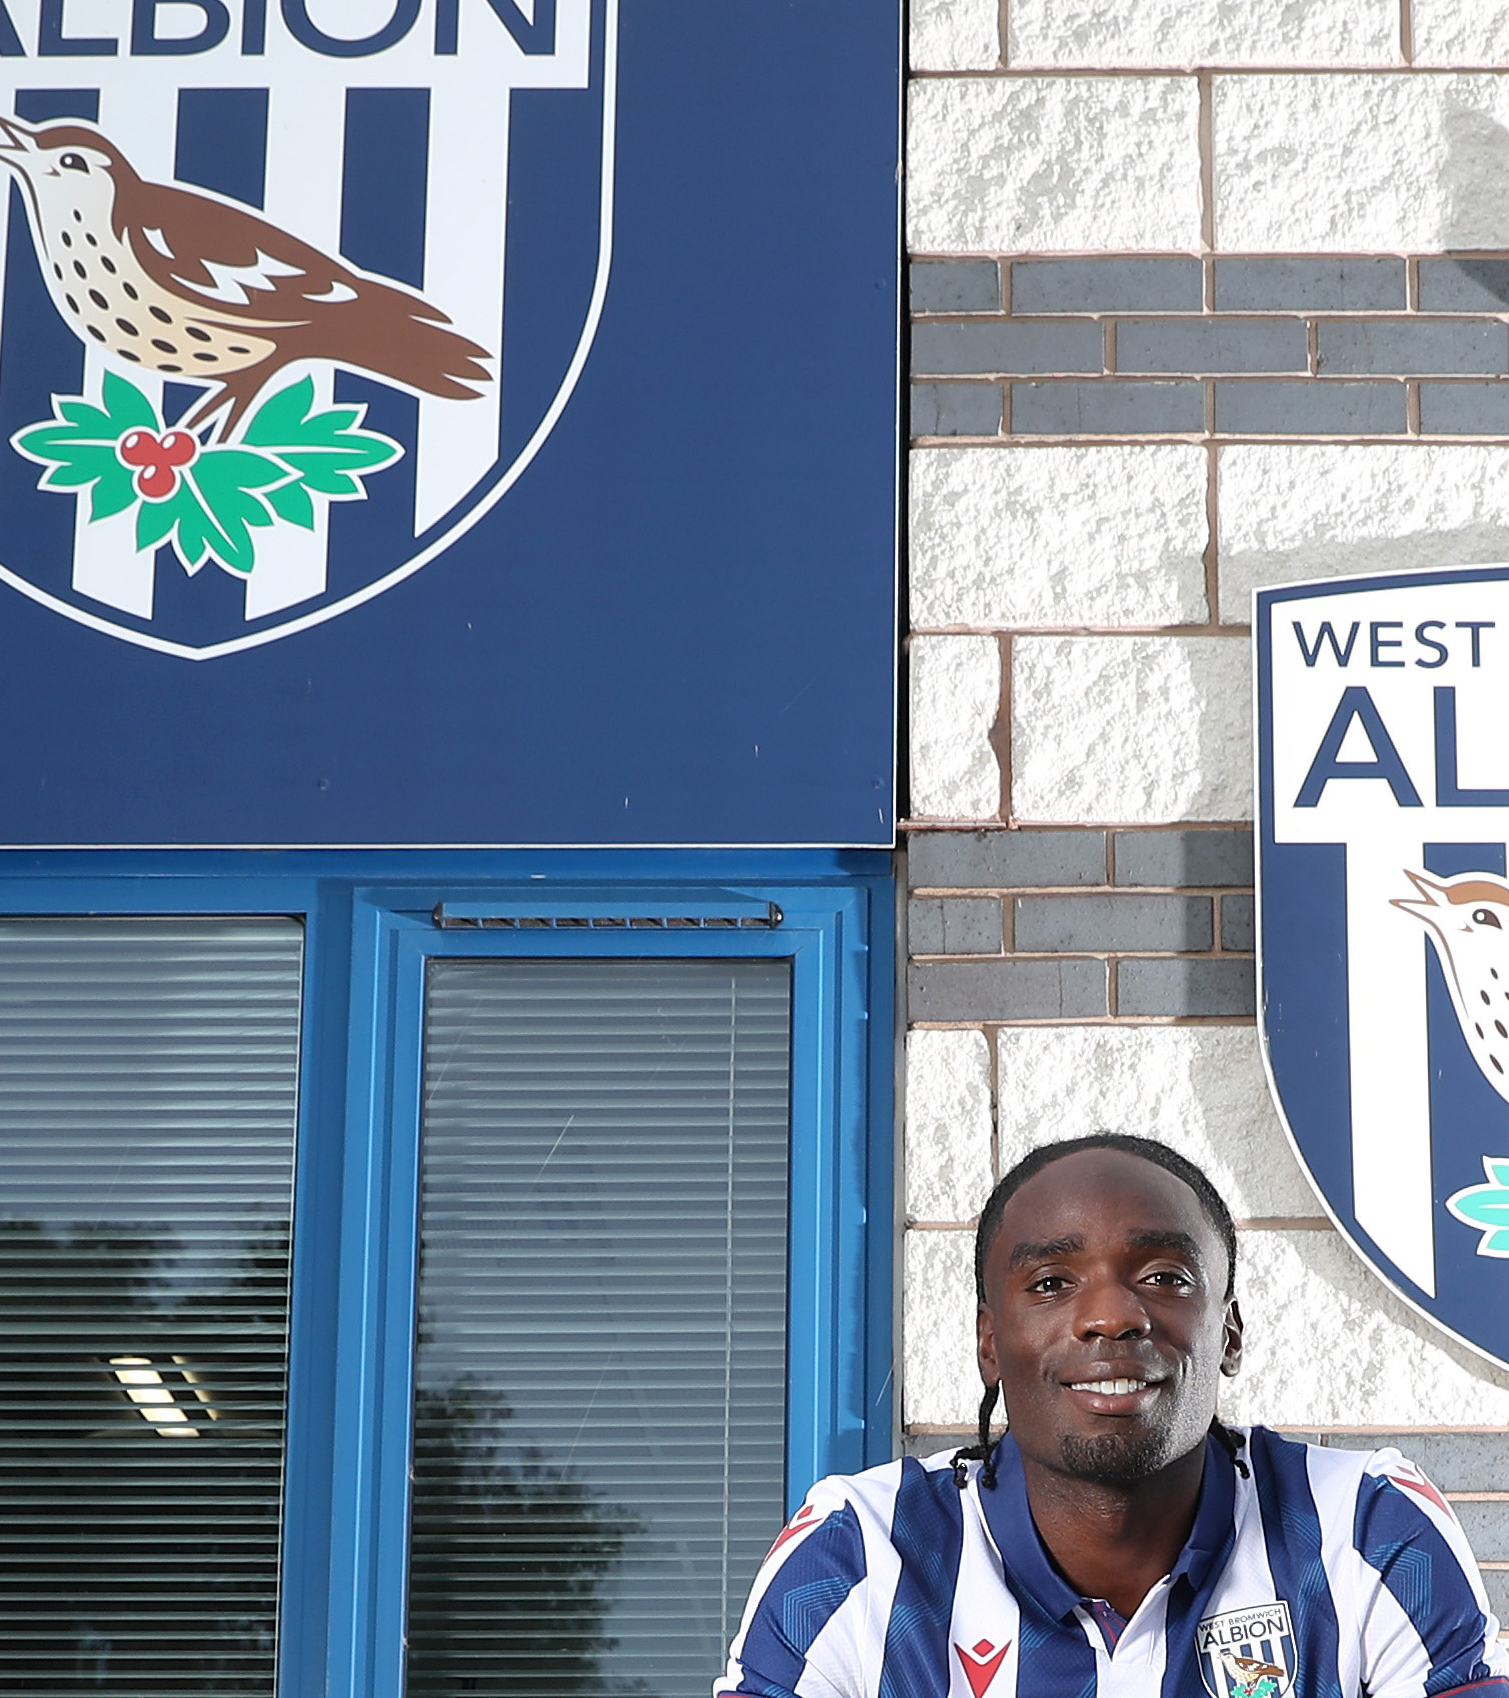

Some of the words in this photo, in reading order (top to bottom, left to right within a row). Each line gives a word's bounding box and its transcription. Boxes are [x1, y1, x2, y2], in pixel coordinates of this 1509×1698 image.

[1291, 620, 1496, 669] WEST
[1198, 1620, 1224, 1632] WEST
[1229, 1608, 1281, 1626] BROMWICH
[1203, 1616, 1284, 1649] ALBION
